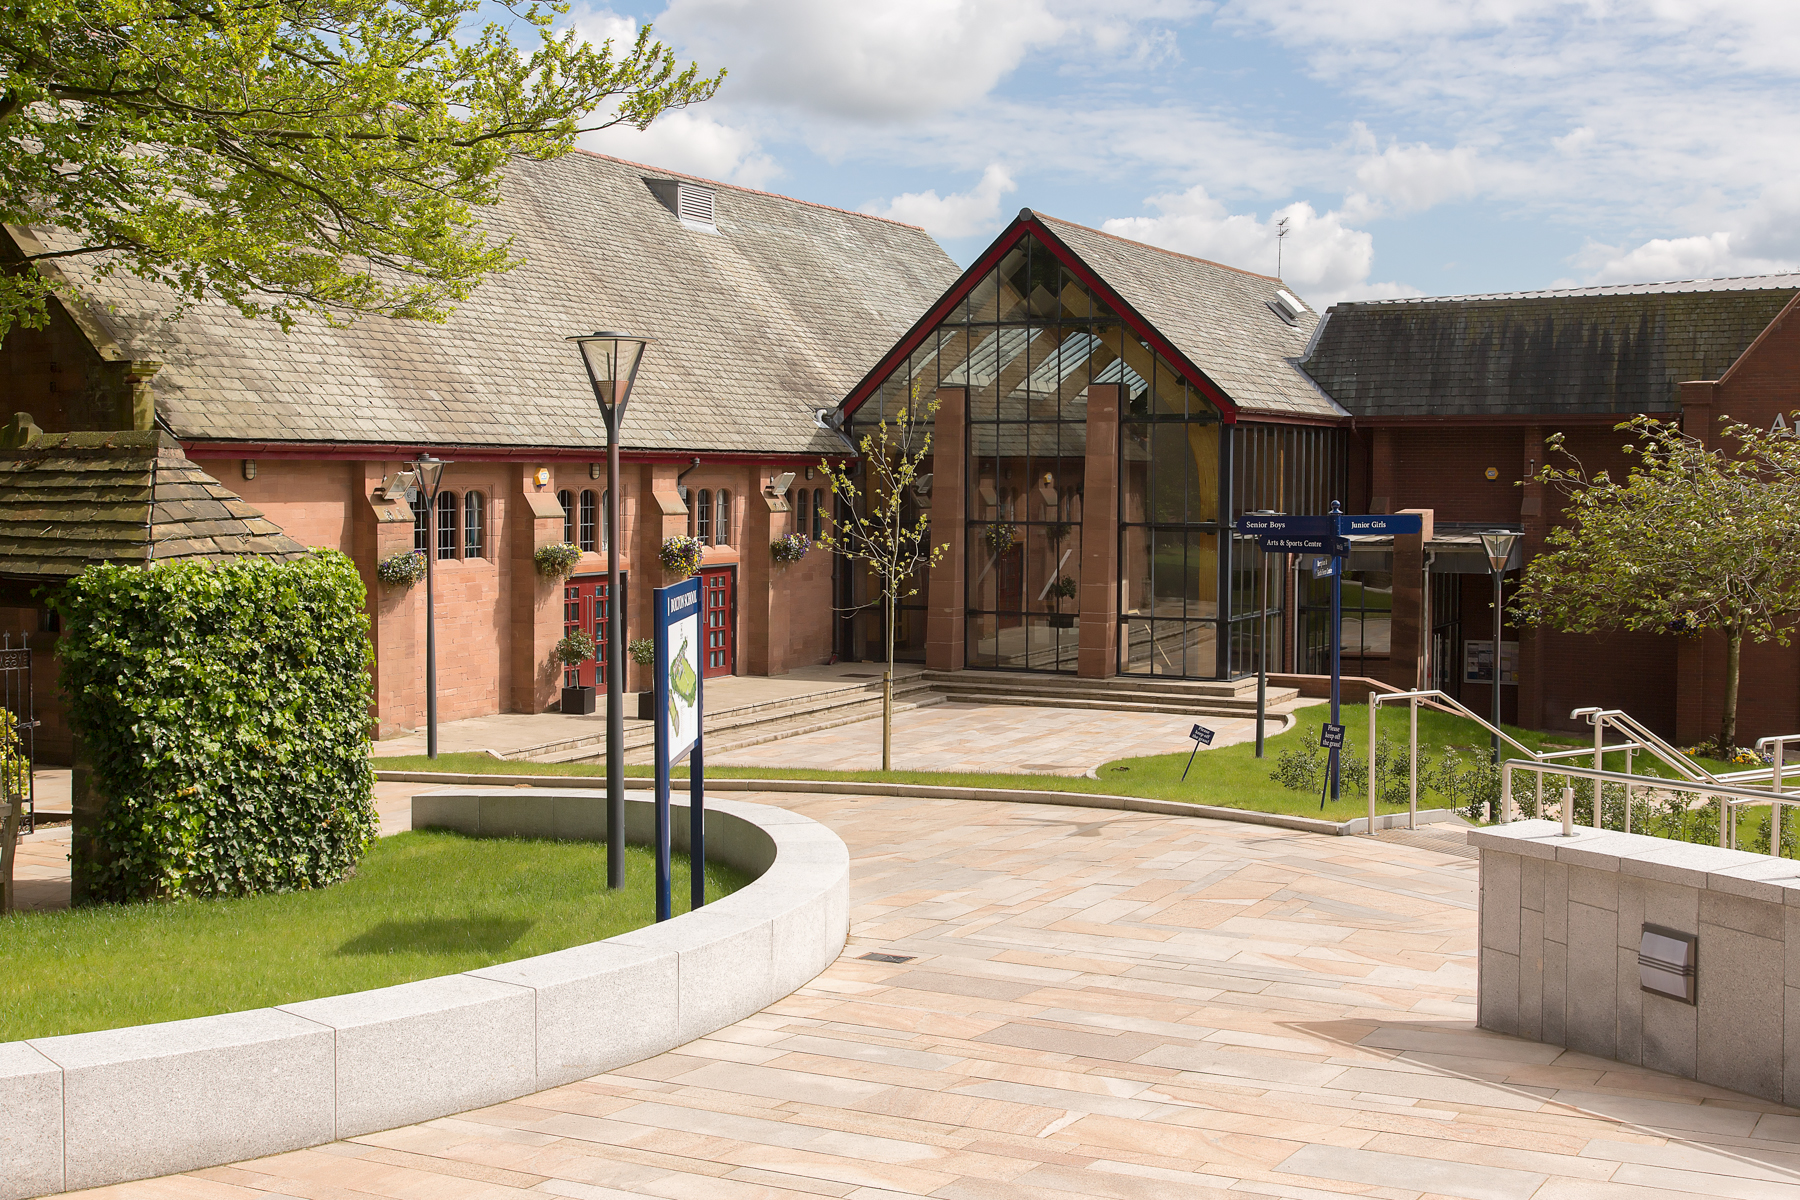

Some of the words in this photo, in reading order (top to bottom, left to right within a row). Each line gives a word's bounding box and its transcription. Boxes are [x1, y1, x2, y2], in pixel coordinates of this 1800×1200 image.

[1270, 521, 1286, 530] Boys
[1351, 521, 1370, 529] Junior
[1285, 540, 1303, 548] Sports
[670, 594, 684, 613] BOLTON
[684, 590, 697, 607] SCHOOL
[1327, 724, 1340, 732] Please
[1325, 731, 1334, 740] keep
